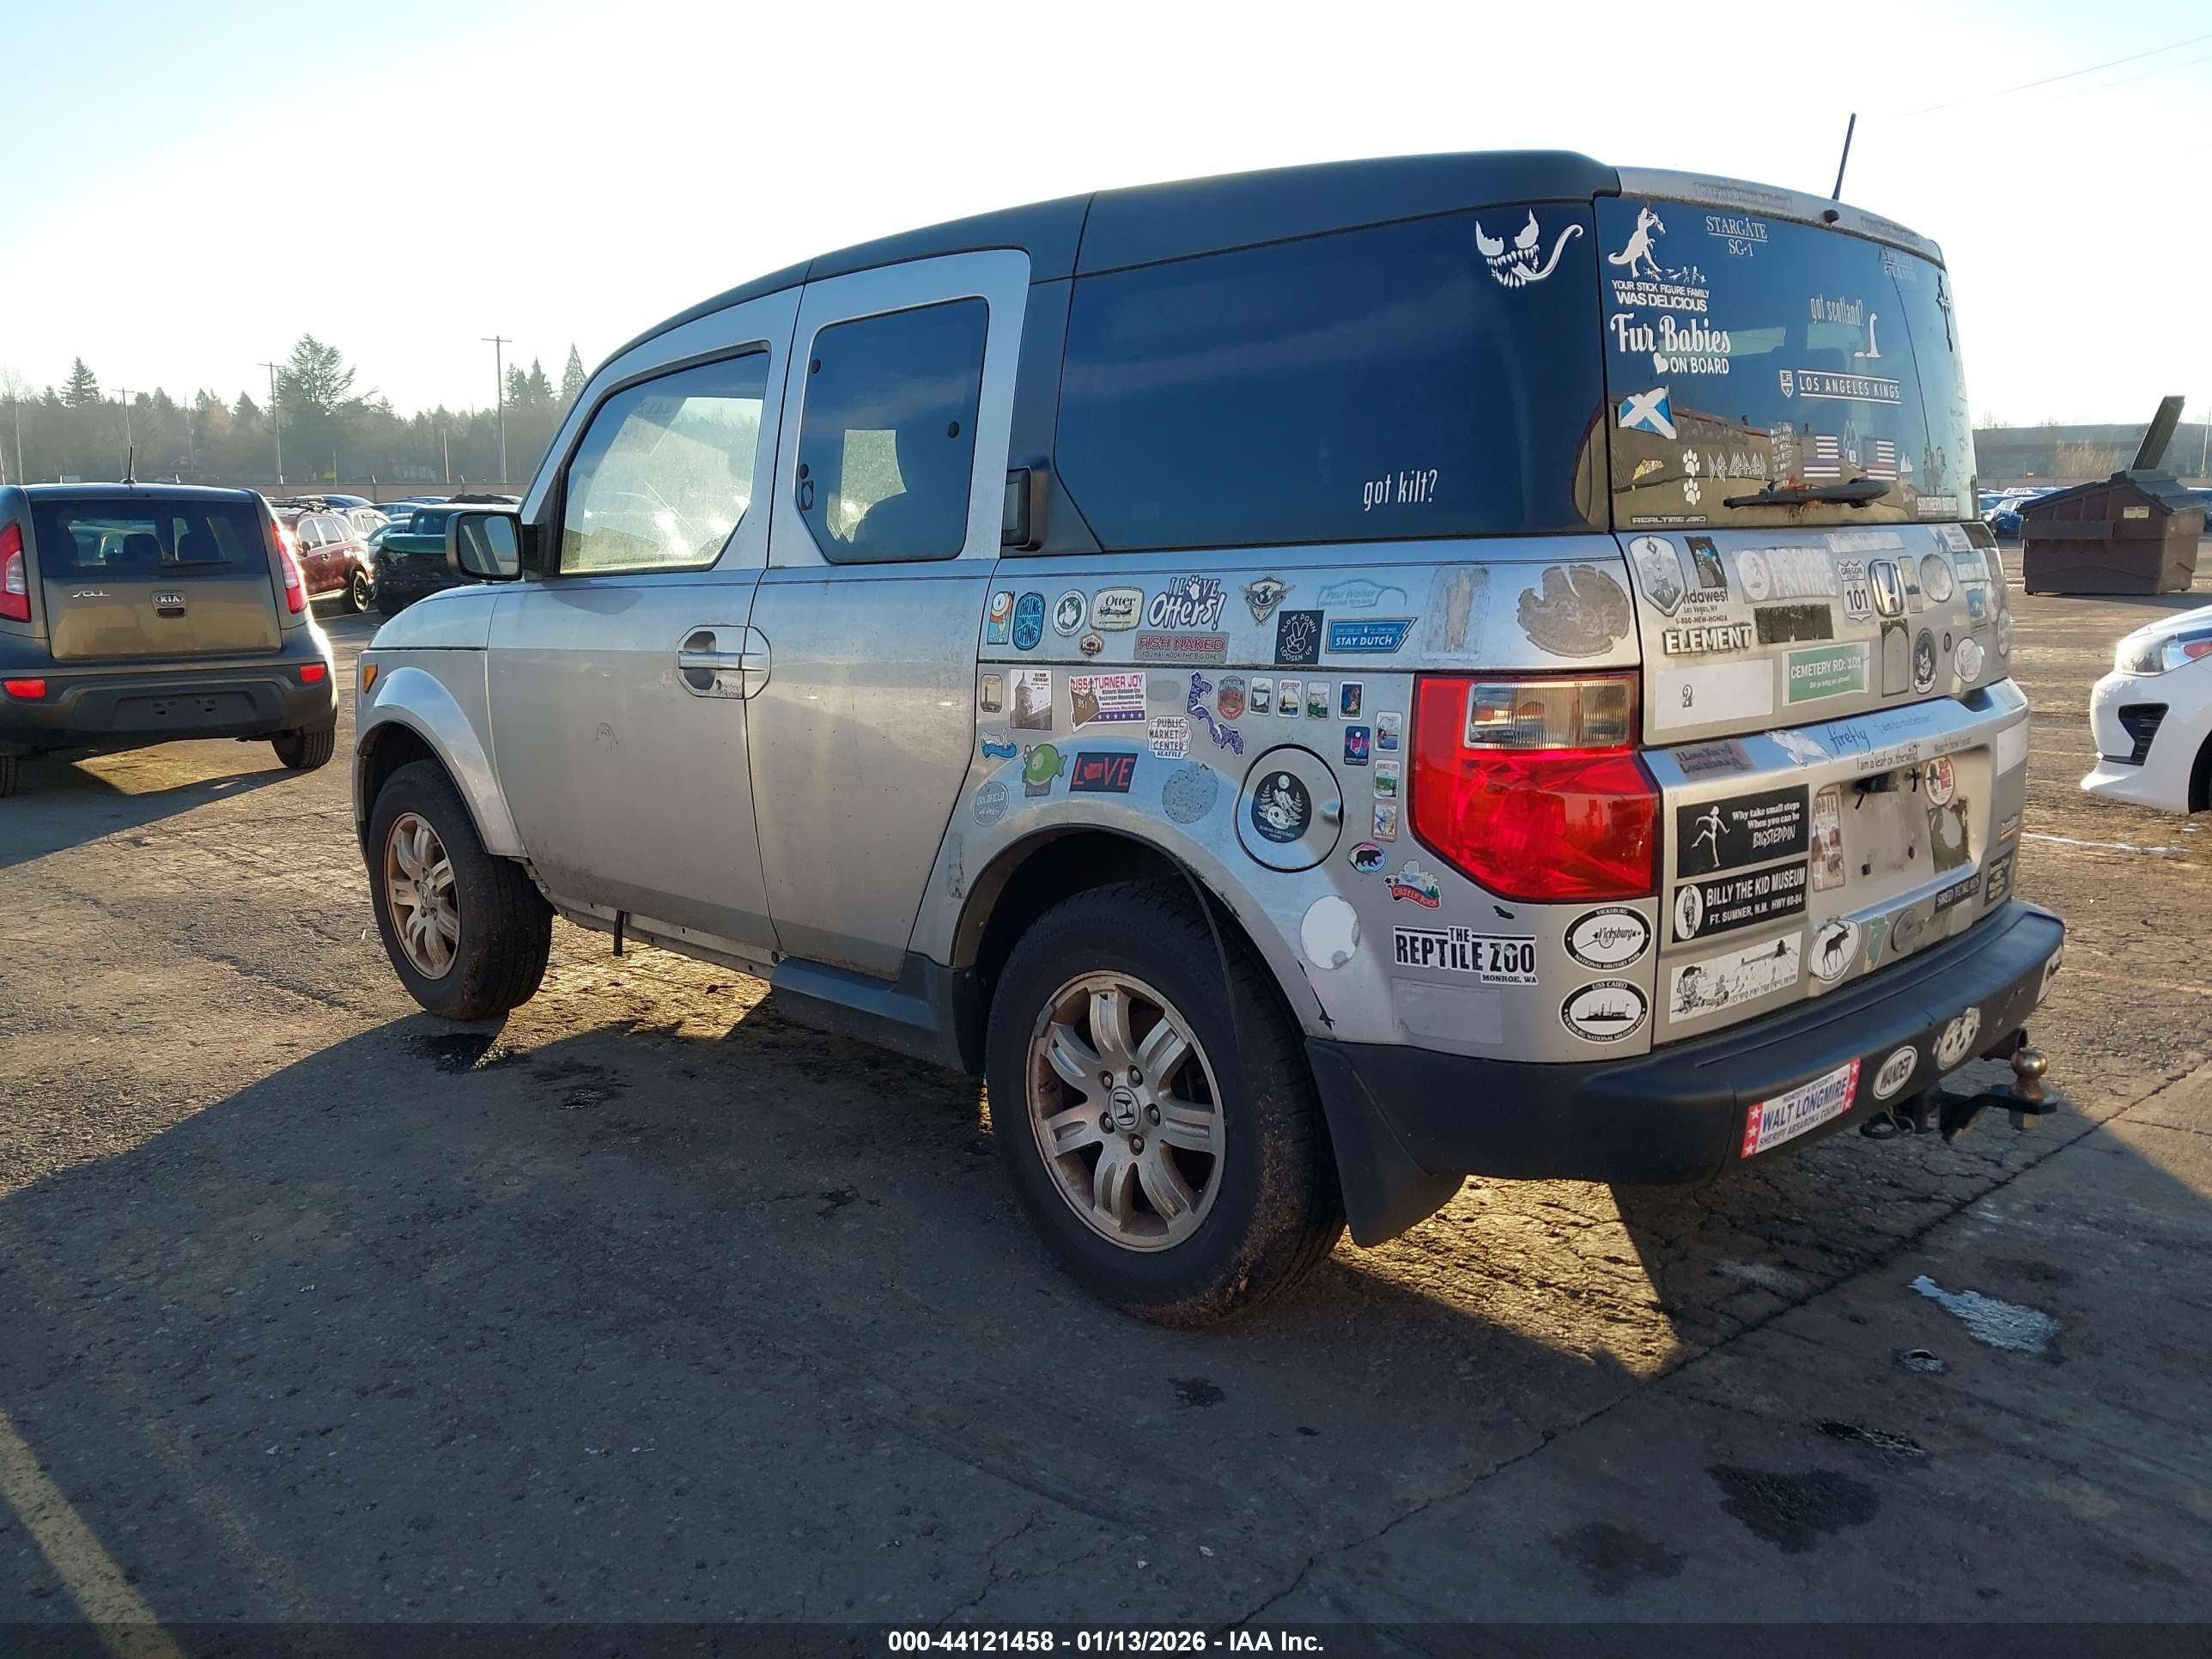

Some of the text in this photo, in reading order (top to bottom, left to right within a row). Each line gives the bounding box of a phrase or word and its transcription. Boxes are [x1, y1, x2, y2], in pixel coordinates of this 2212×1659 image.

[1705, 216, 1768, 240] STARGATE
[1612, 280, 1711, 299] YOUR STICK FIGURE FAMILY
[1616, 291, 1708, 312] WAS DELICIOUS
[1810, 294, 1826, 324] got
[1610, 313, 1732, 354] Fur Babies
[1670, 356, 1729, 374] ON BOARD
[1799, 375, 1899, 399] LOS ANGELES KINGS
[1364, 469, 1437, 512] got kilt?
[1841, 567, 1863, 575] OREGON
[1105, 595, 1135, 606] Otter
[1847, 589, 1869, 611] 101
[1148, 592, 1227, 631] Otters!
[1280, 613, 1317, 633] SLOW DOWN
[1139, 635, 1225, 652] FISH NAKED
[1335, 635, 1393, 646] STAY DUTCH
[1662, 625, 1752, 654] ELEMENT
[1279, 646, 1314, 662] LOOSEN UP
[1790, 660, 1832, 679] CEMETERY
[1848, 656, 1862, 669] 101
[1073, 674, 1143, 690] USS TURNER JOY
[1158, 718, 1185, 728] PUBLIC
[1149, 730, 1179, 739] MARKET
[1827, 725, 1871, 754] firefly
[1153, 741, 1184, 750] CENTER
[1732, 801, 1801, 822] Why take small steps
[1747, 812, 1800, 830] When you can be
[1706, 866, 1806, 907] BILLY THE KID MUSEUM
[1710, 893, 1802, 926] FT. SUMNER, N.M. HWY 60-84
[1449, 927, 1470, 943] THE
[1598, 927, 1633, 941] Vicksburg
[1395, 934, 1535, 973] REPTILE ZOO
[1574, 953, 1602, 969] NATIONAL
[1628, 953, 1641, 963] PARK
[1613, 1026, 1636, 1040] MILITARY
[1763, 1078, 1847, 1133] WALT LONGMIRE
[1759, 1127, 1787, 1147] SHERIFF
